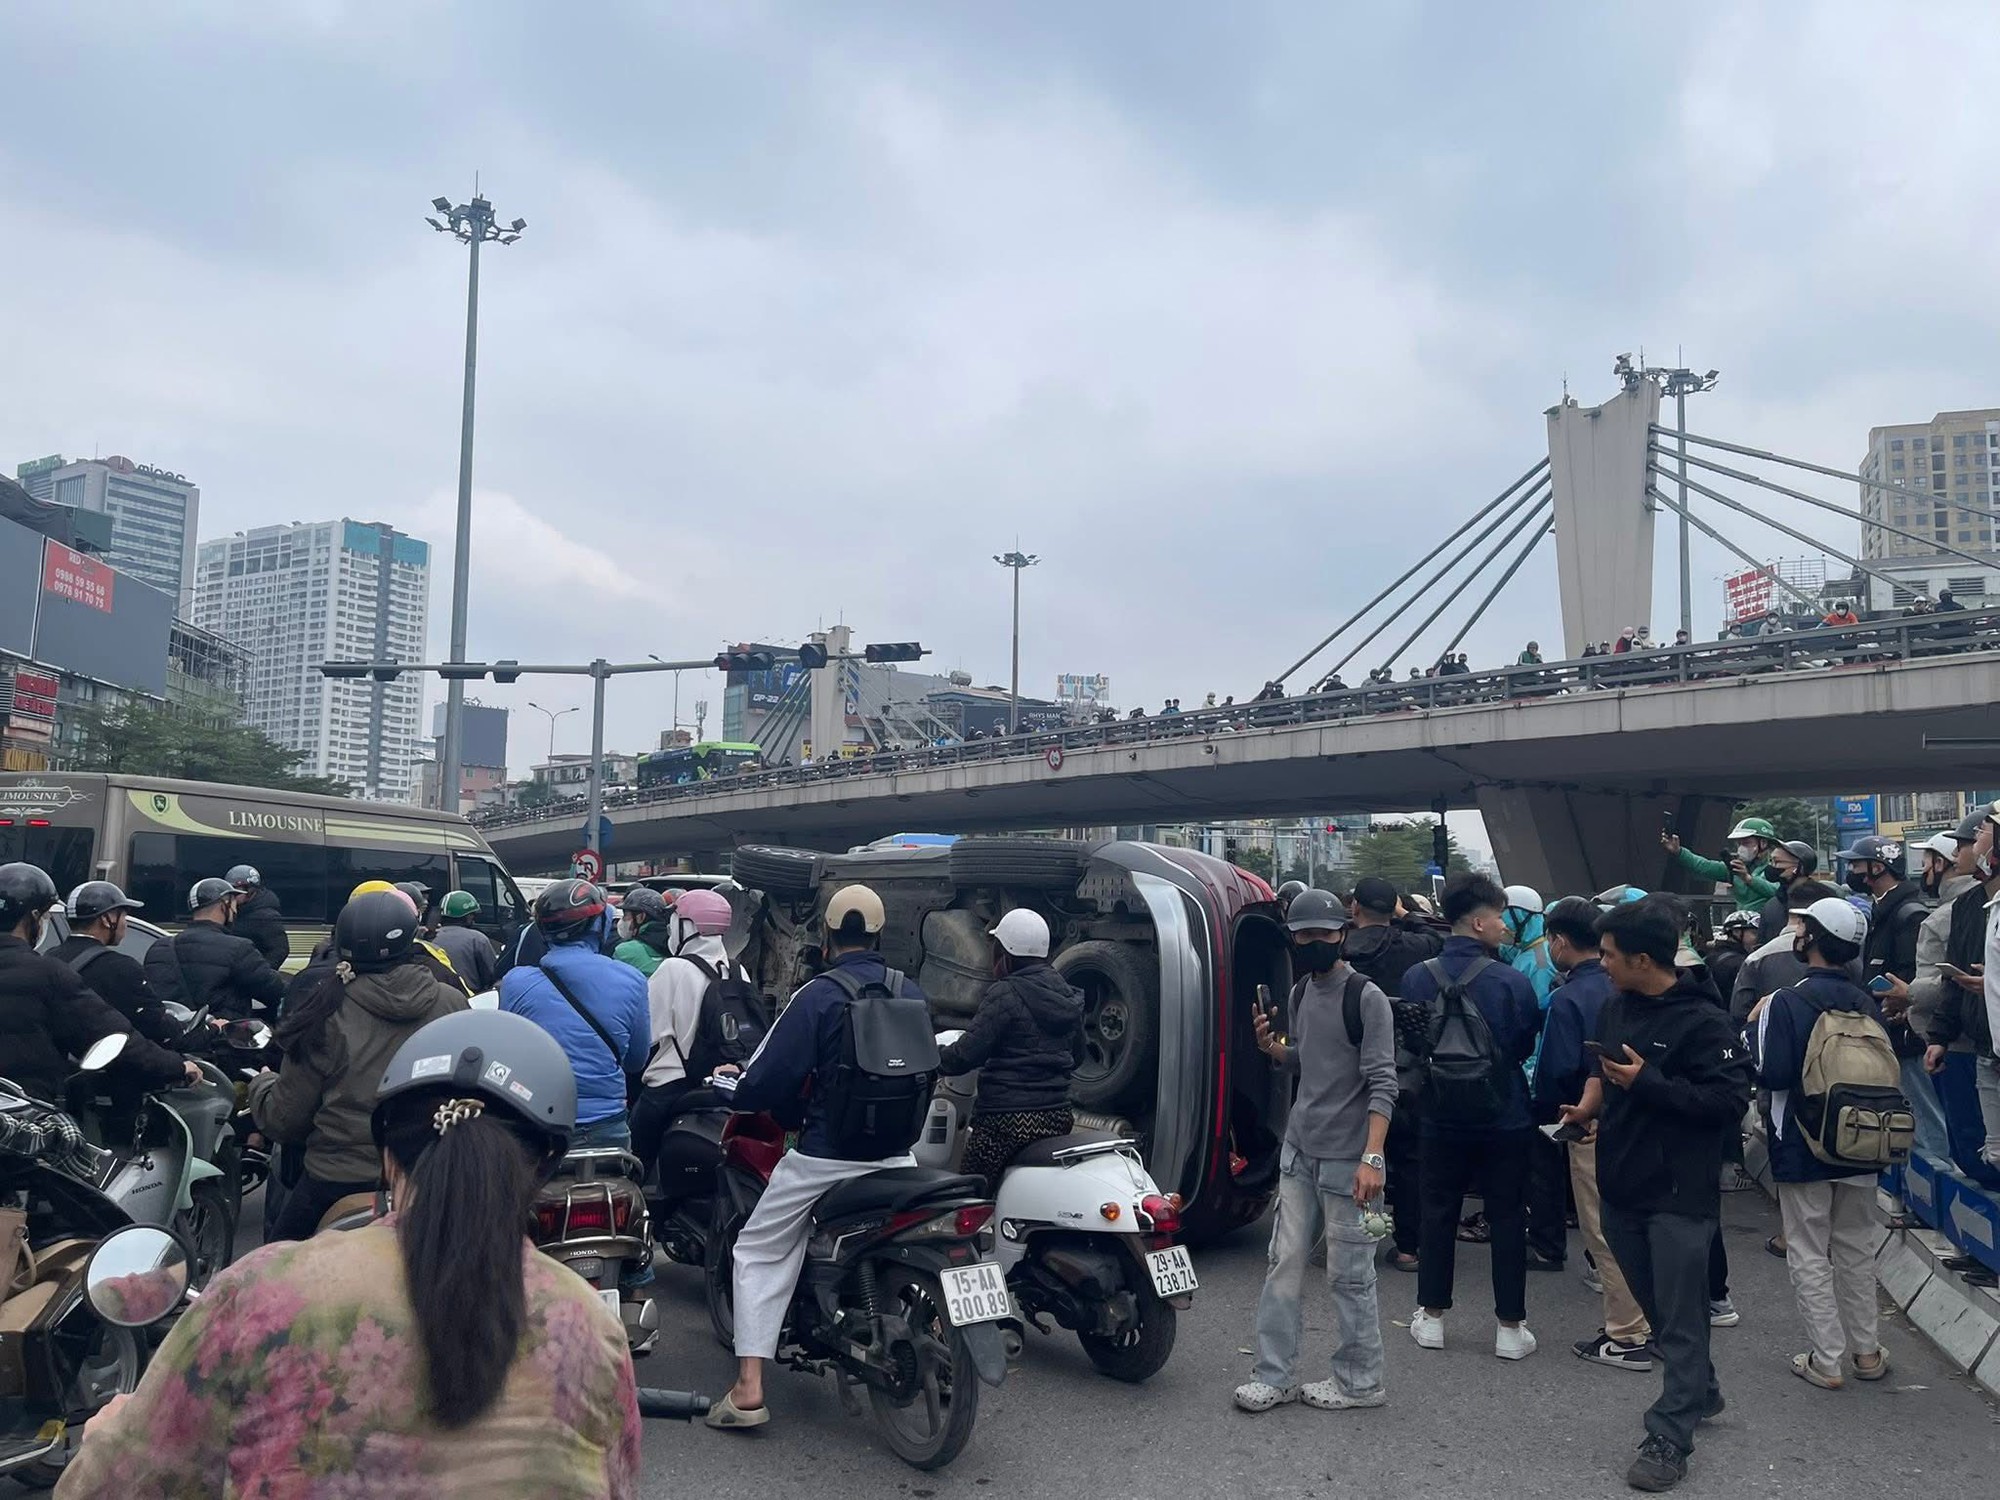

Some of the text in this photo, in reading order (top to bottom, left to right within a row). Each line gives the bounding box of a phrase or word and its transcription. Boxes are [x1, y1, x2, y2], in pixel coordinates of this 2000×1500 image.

[85, 592, 94, 604] 70
[95, 596, 104, 608] 75
[229, 810, 323, 833] LIMOUSINE
[132, 1181, 163, 1195] HONDA
[1153, 1250, 1187, 1272] 29-AA
[952, 1268, 998, 1295] 15-AA
[1156, 1269, 1197, 1295] 238.74
[951, 1291, 1008, 1321] 300.89
